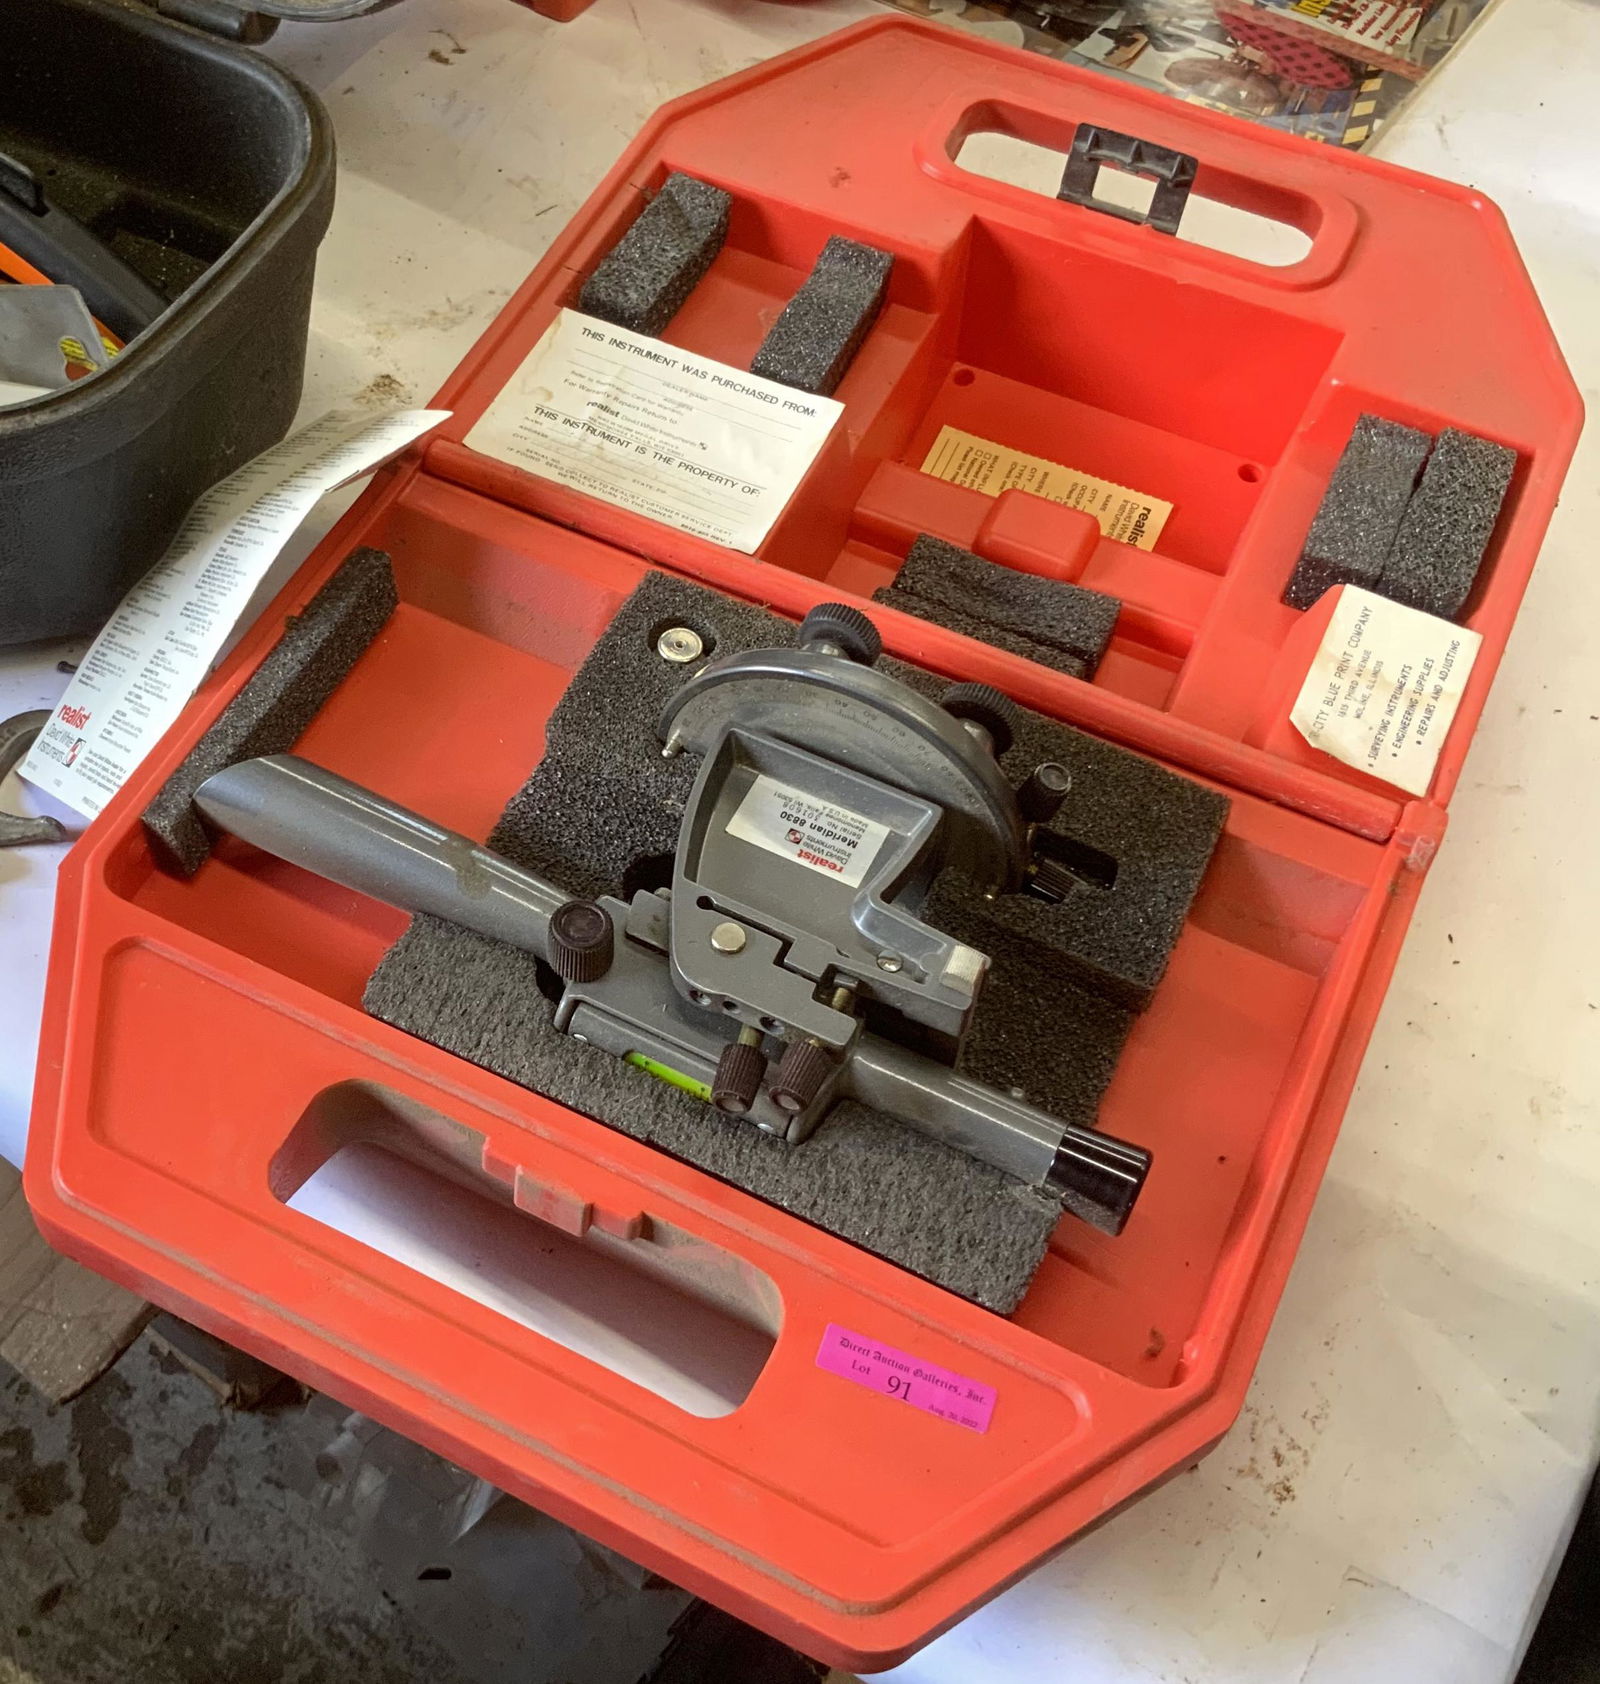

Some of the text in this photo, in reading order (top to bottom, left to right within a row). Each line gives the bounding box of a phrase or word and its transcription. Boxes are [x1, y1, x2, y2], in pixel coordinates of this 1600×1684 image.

[582, 327, 815, 416] THIS INSTRUMENT WAS PURCHASED FROM:
[563, 378, 577, 387] For
[612, 395, 640, 411] Repairs
[641, 407, 667, 421] Return
[586, 401, 620, 418] realist
[534, 406, 559, 421] THIS
[562, 418, 631, 447] INSTRUMENT
[634, 445, 647, 455] IS
[653, 451, 675, 465] THE
[678, 461, 737, 488] PROPERTY
[1026, 467, 1037, 482] CITY
[587, 483, 618, 498] RETURN
[1071, 485, 1088, 509] OCCUPA
[1087, 488, 1098, 504] CITY
[640, 498, 680, 516] CUSTOMER
[1124, 502, 1140, 523] David
[1322, 682, 1341, 707] BLUE
[1334, 651, 1353, 679] PRINT
[1347, 606, 1372, 648] COMPANY
[1344, 679, 1359, 701] THIRD
[1354, 650, 1371, 678] AVENUE
[1366, 661, 1383, 690] ILLINOIS
[1416, 640, 1460, 736] REPAIRS AND ADJUSTING
[1368, 665, 1412, 760] SURVEYING INSTRUMENTS
[1392, 658, 1434, 748] ENGINEERING SUPPLIES
[58, 704, 92, 730] realist
[780, 811, 858, 848] Meridian 8830
[839, 827, 862, 839] Serial
[850, 817, 868, 828] Made
[802, 841, 848, 864] David White
[806, 835, 852, 858] Instruments
[797, 849, 843, 873] realist
[839, 1336, 984, 1403] Direct Auction Galleries, Inc.
[851, 1359, 871, 1375] Lot
[887, 1375, 911, 1401] 91
